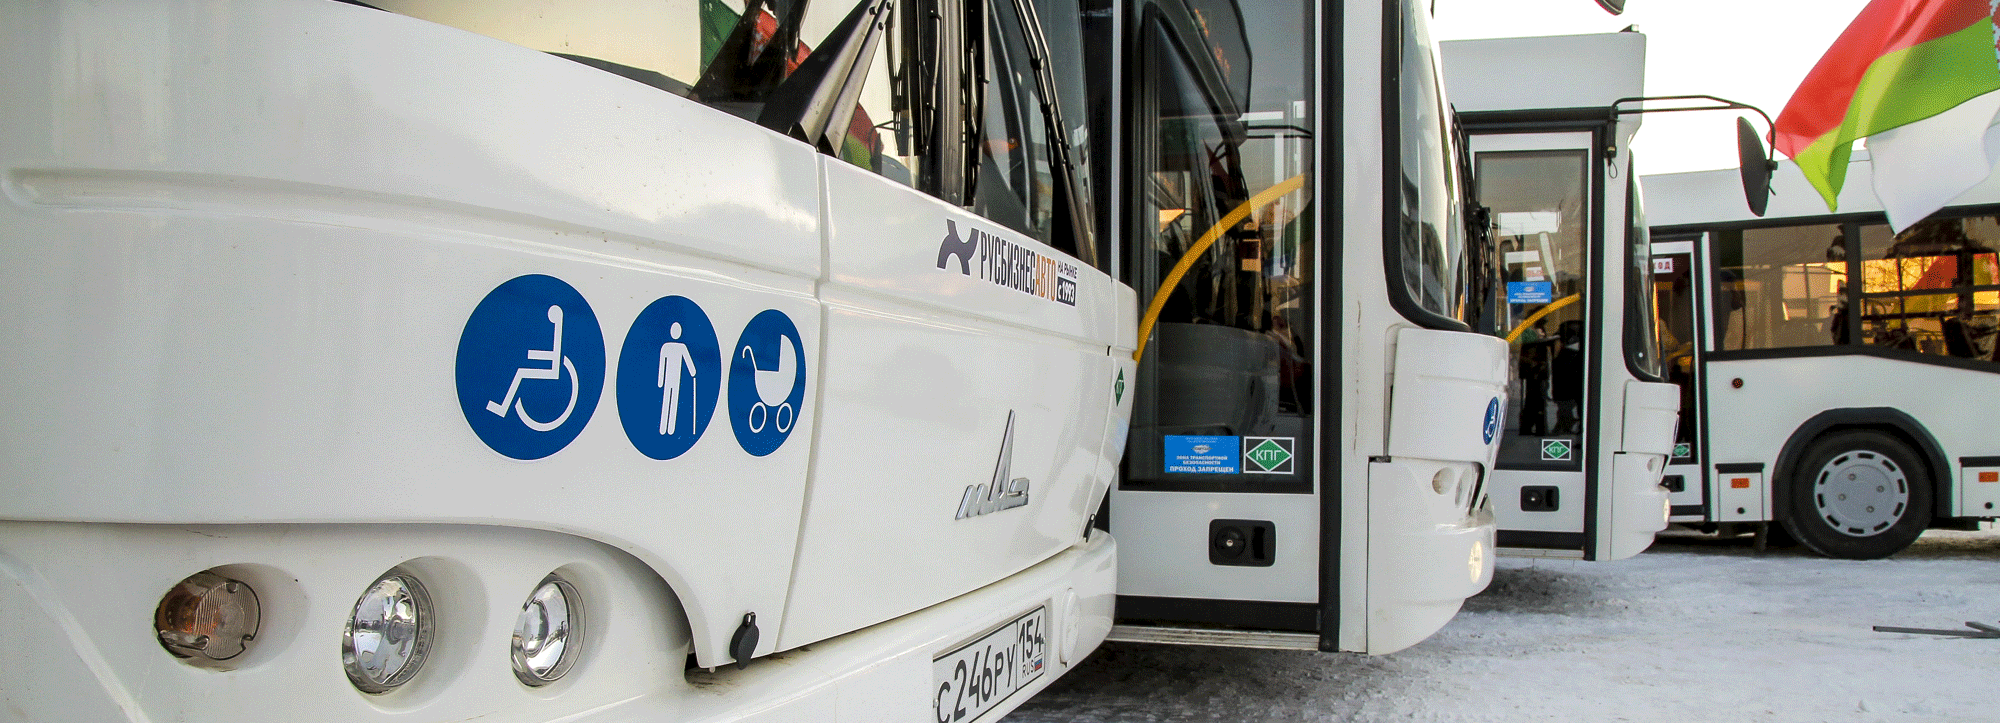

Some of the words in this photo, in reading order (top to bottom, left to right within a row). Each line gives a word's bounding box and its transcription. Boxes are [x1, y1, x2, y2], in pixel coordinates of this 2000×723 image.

[980, 231, 1056, 301] РУСБИЗНЕСАВТО
[1255, 449, 1282, 461] КПГ
[936, 644, 1016, 723] С246РУ
[1019, 615, 1042, 663] 154
[1022, 659, 1035, 679] RUS
